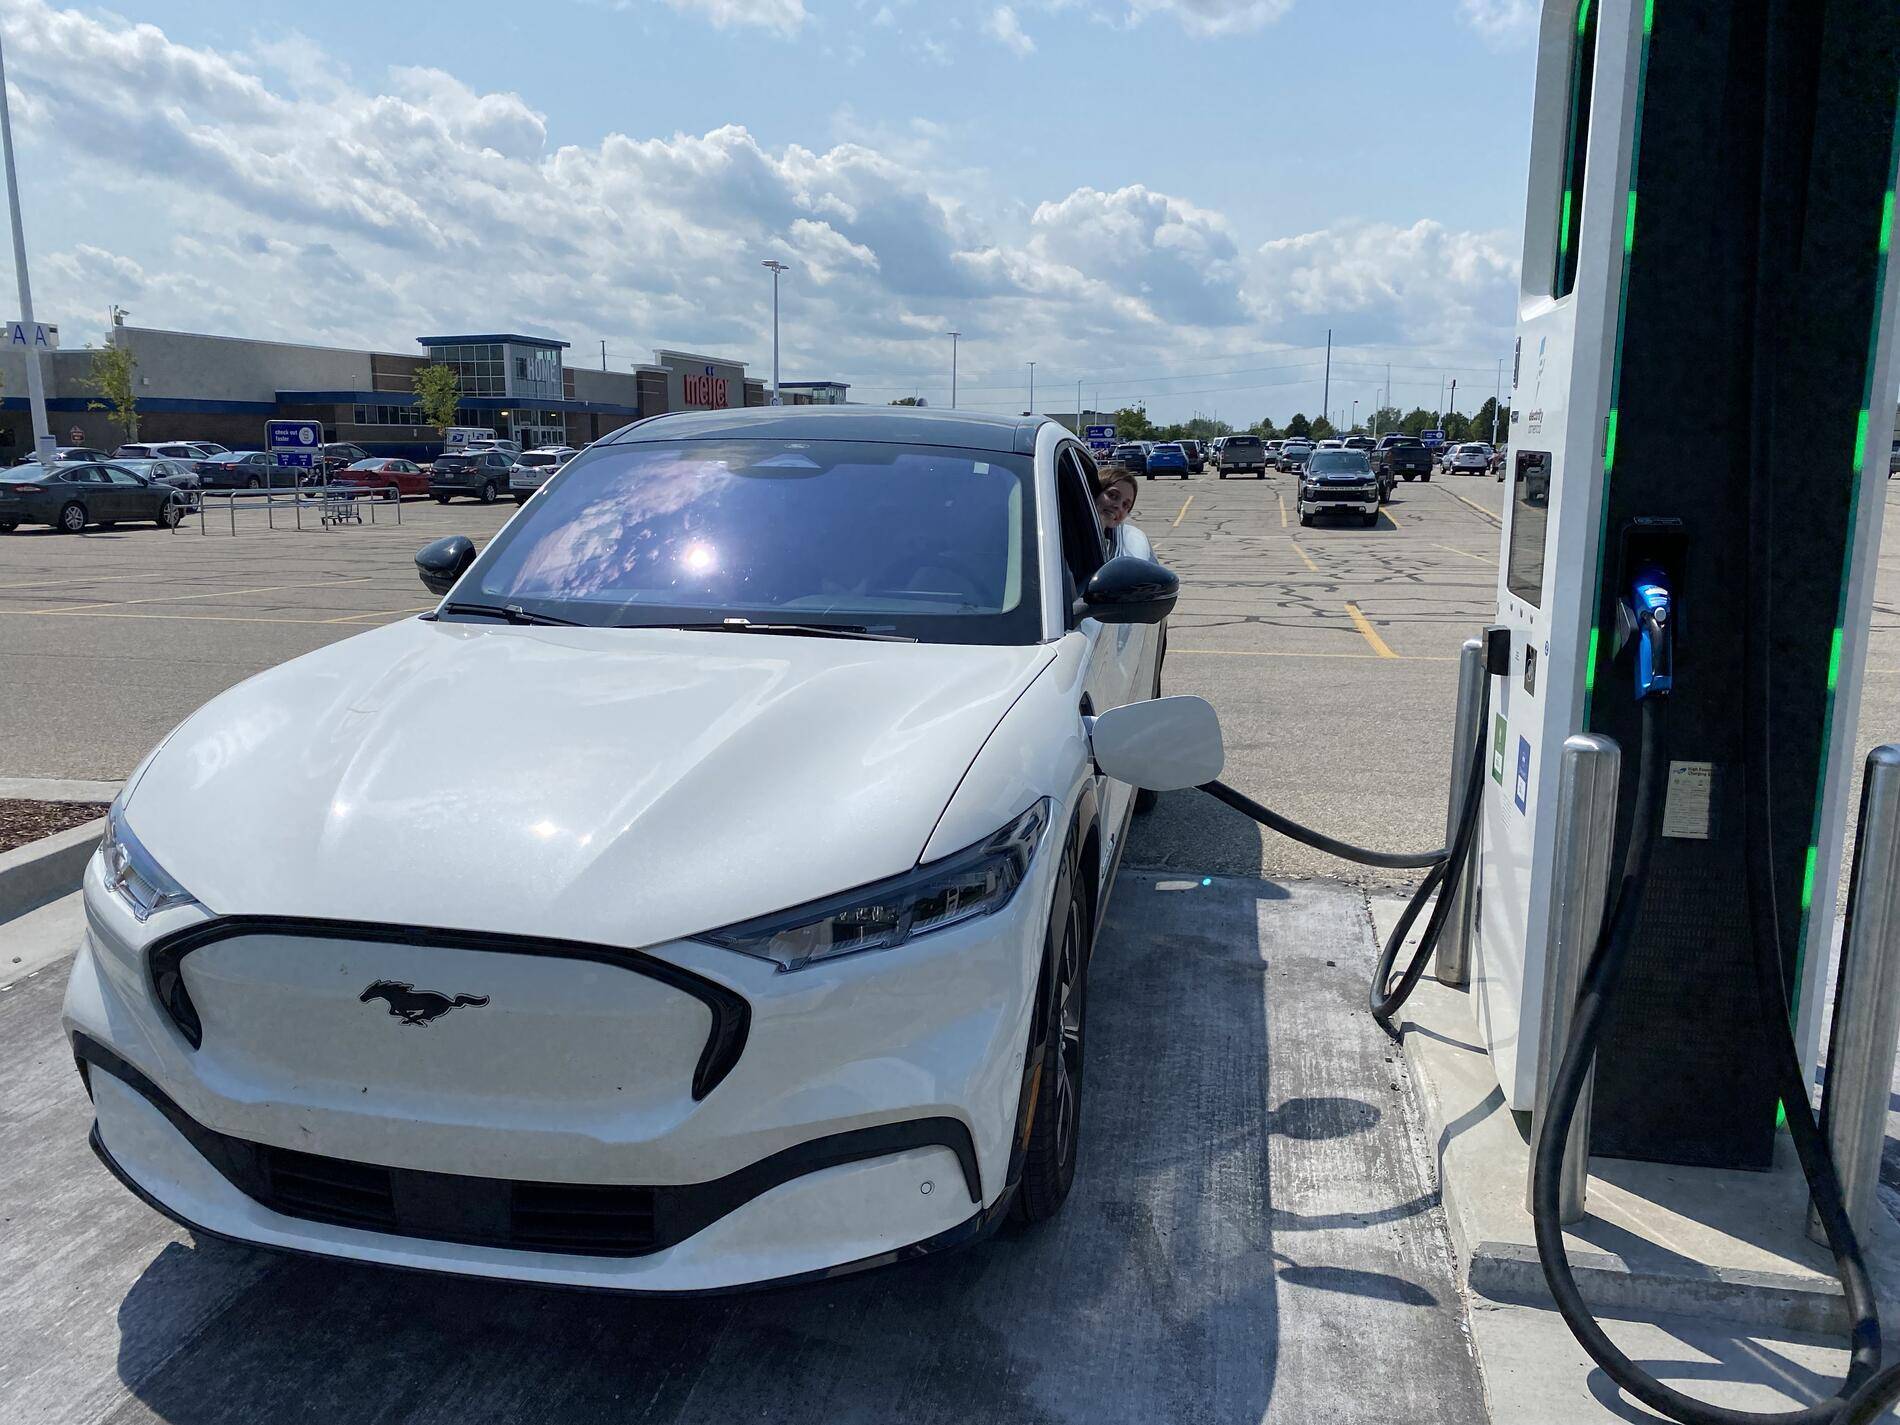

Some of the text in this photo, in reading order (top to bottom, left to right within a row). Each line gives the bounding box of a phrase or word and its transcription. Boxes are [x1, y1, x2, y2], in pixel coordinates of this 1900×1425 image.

[13, 324, 26, 345] A
[35, 325, 47, 346] A
[526, 357, 557, 382] HOME
[683, 366, 729, 410] meijer
